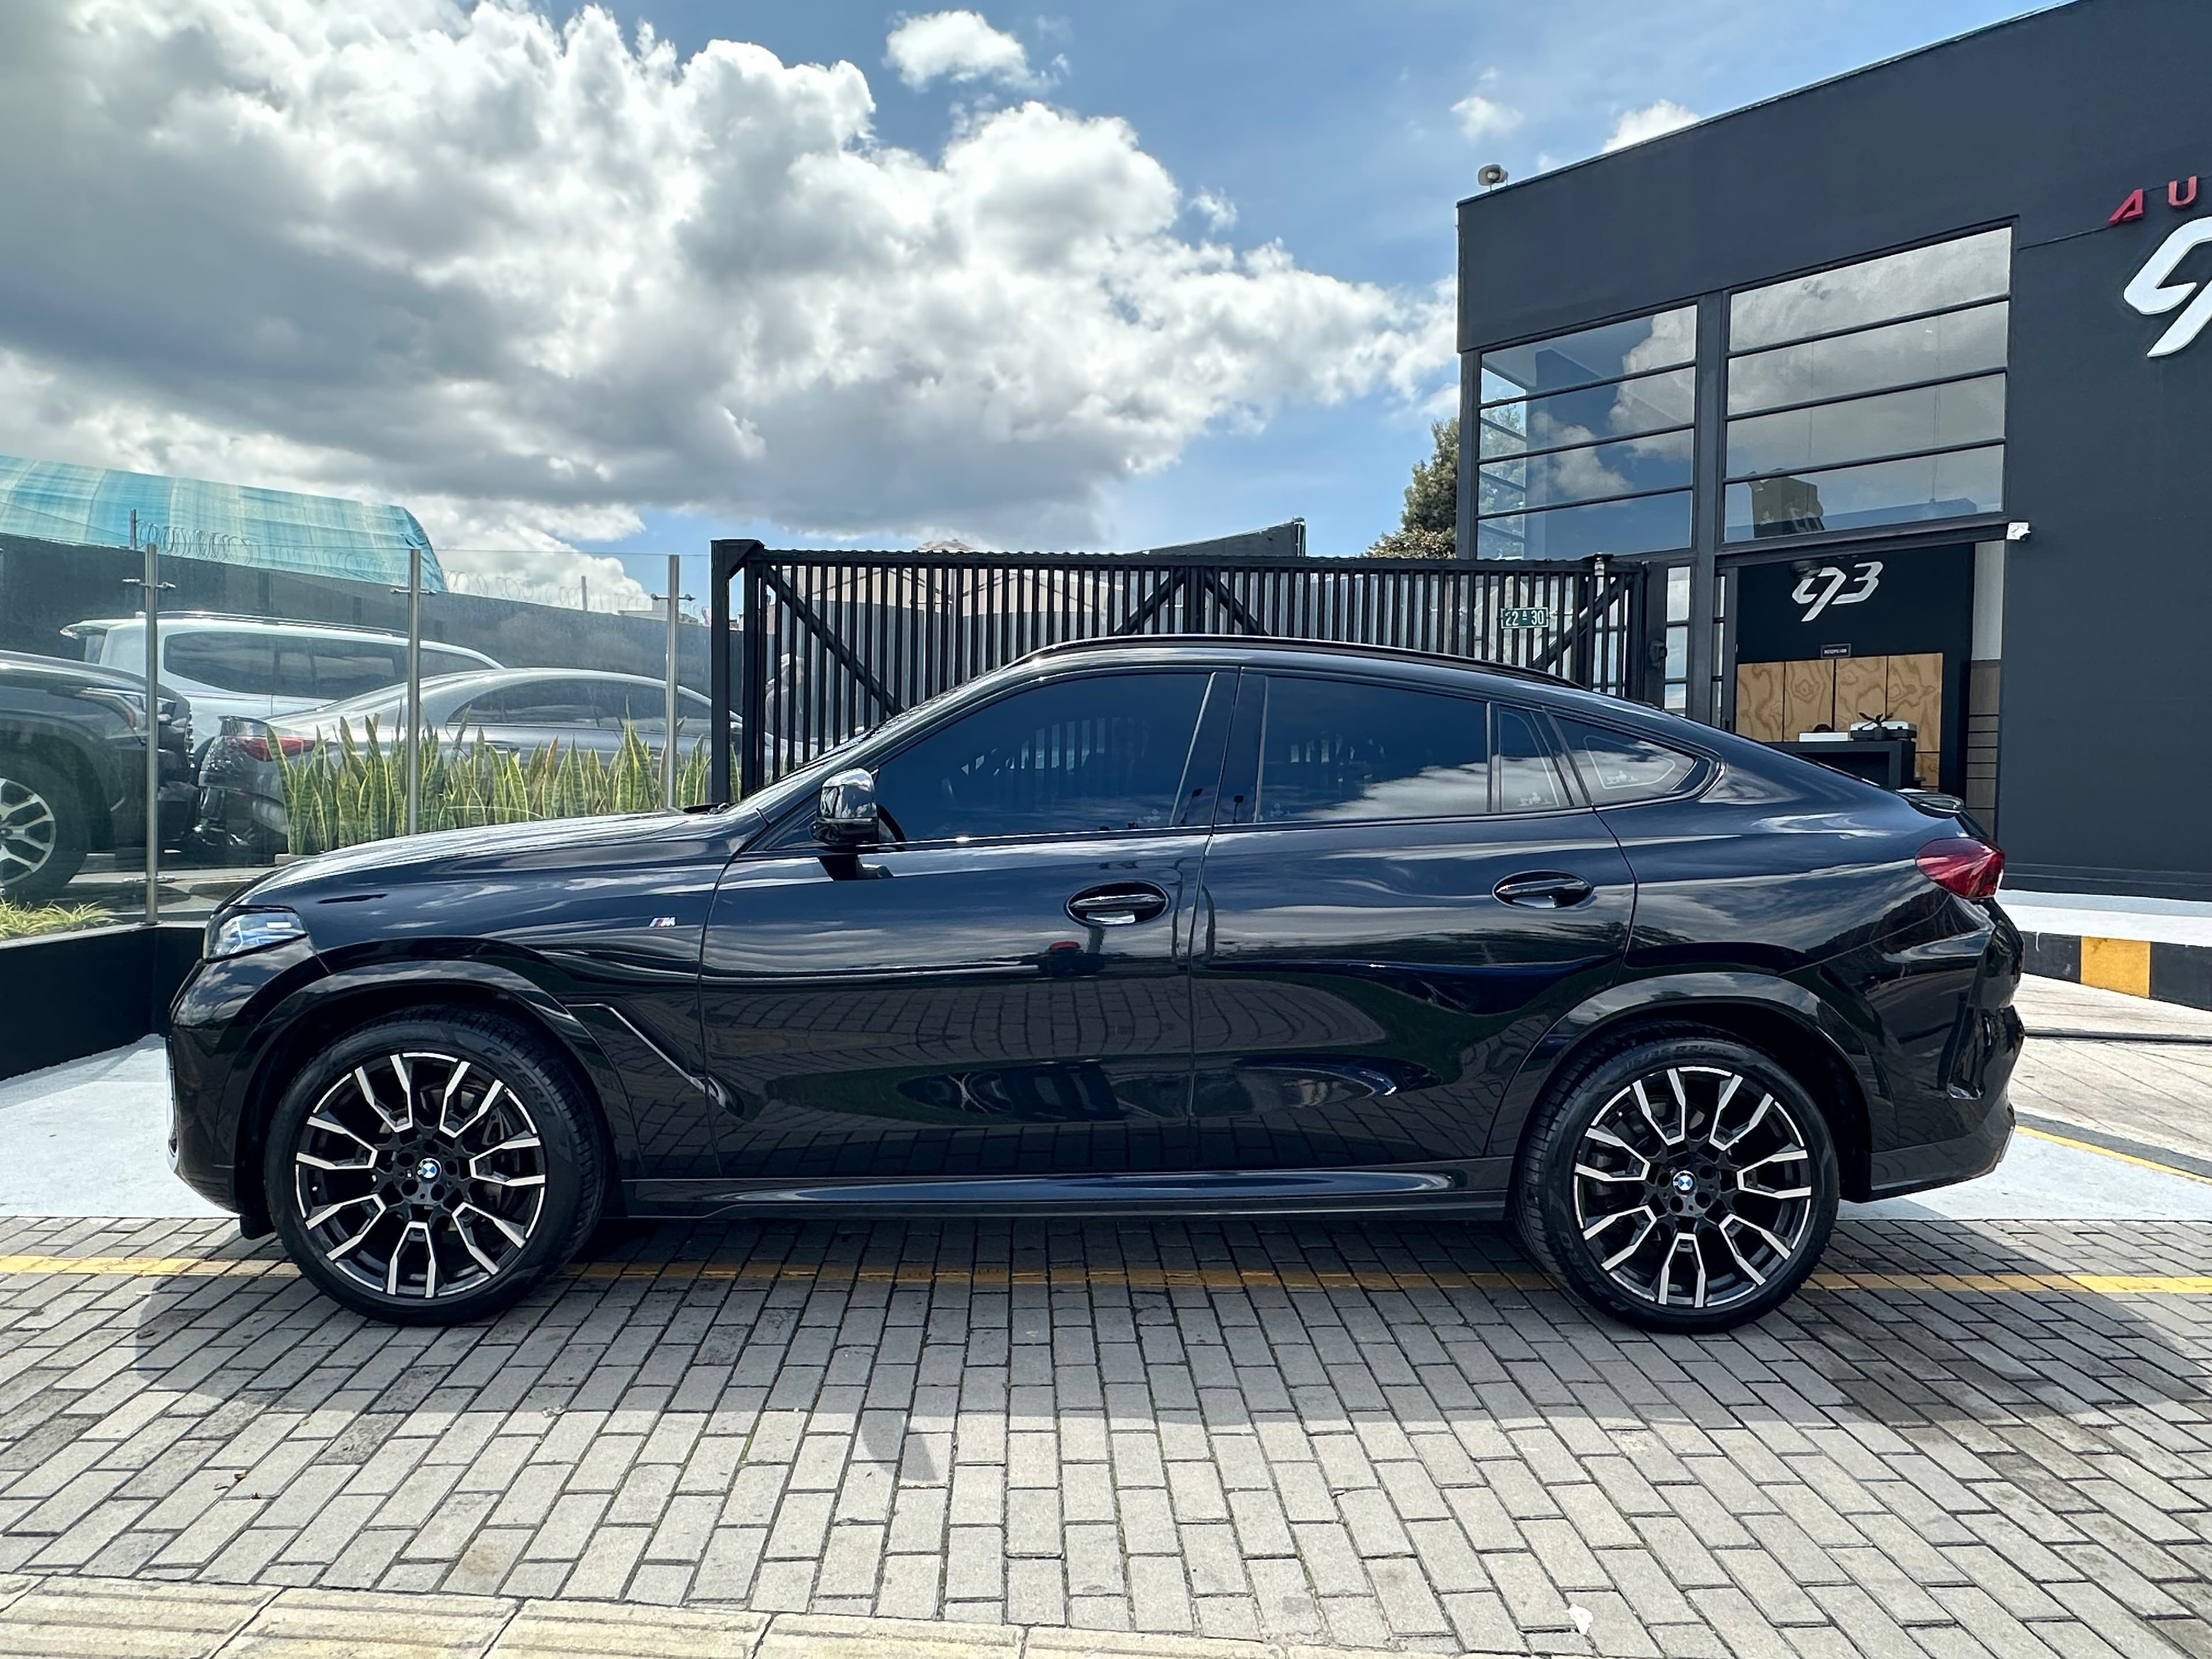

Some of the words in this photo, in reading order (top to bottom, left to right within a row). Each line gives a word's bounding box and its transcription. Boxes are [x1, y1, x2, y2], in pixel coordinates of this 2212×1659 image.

[2108, 175, 2198, 222] AU
[1505, 611, 1519, 626] 22
[1531, 610, 1544, 625] 30
[1791, 561, 1883, 622] 93
[482, 1047, 502, 1056] P
[501, 1059, 556, 1117] ZERO
